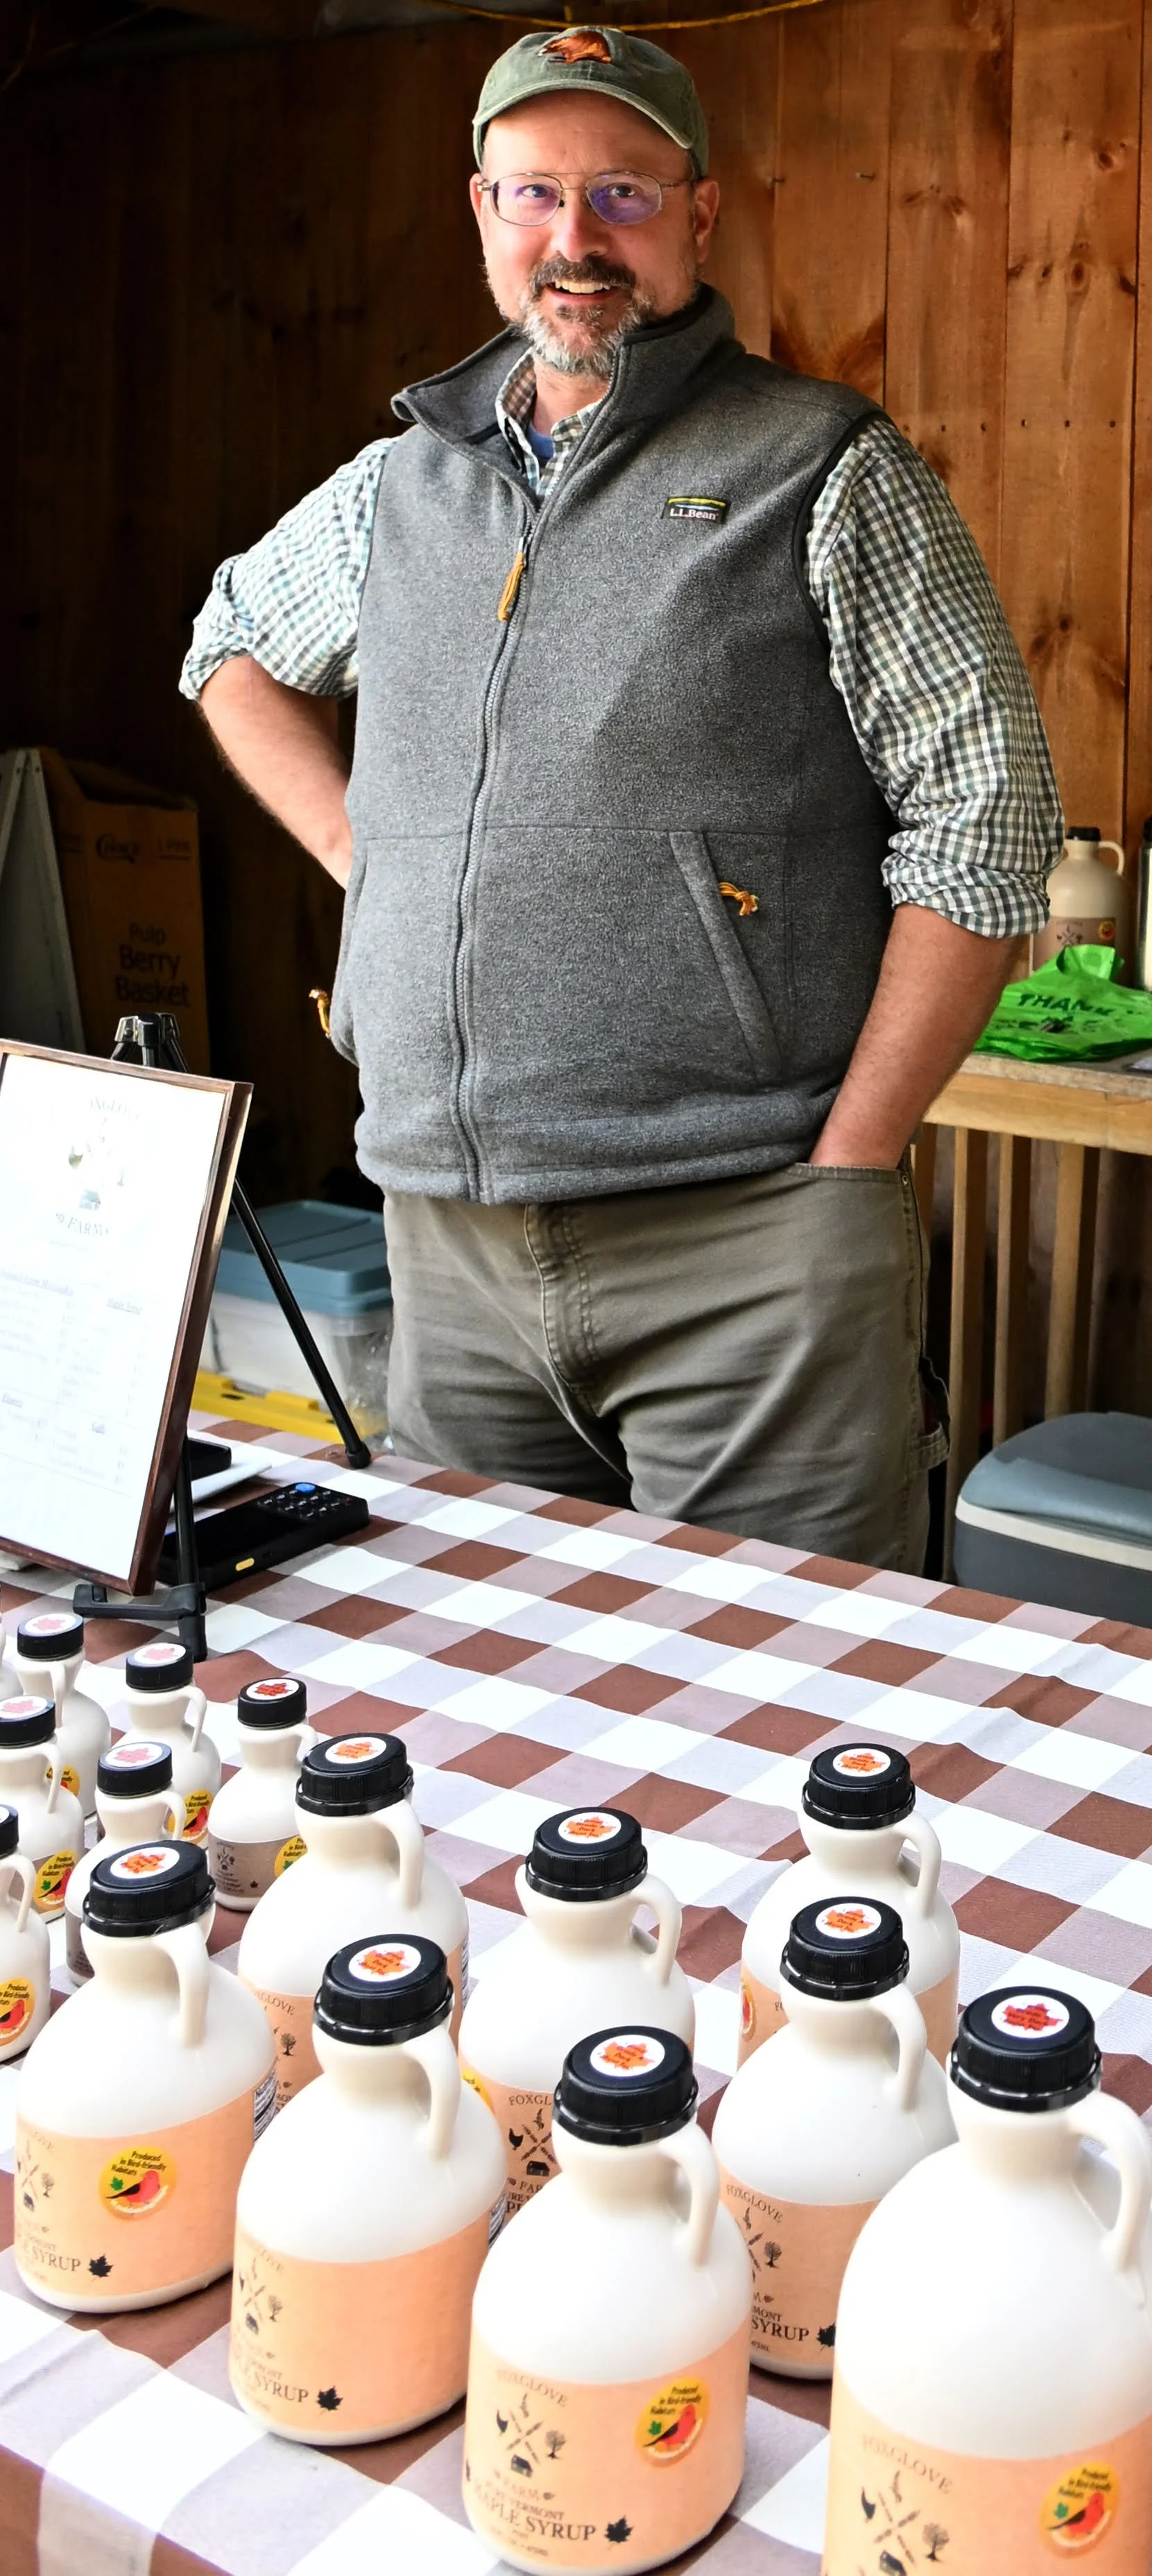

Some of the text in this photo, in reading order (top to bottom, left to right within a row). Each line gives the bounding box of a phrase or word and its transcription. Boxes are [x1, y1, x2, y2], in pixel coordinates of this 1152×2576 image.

[669, 508, 716, 520] L.L.Bean
[129, 922, 166, 946] Pulp
[119, 944, 181, 979] Berry
[115, 976, 190, 1007] Basket
[127, 2159, 166, 2172] Bird-friendly
[132, 2151, 162, 2161] Produced
[111, 2164, 137, 2176] Habitats
[726, 2184, 783, 2223] FOXGLOVE
[32, 2245, 81, 2272] SYRUP
[753, 2306, 782, 2322] MONT
[751, 2317, 809, 2342] SYRUP
[255, 2371, 309, 2403] SYRUP
[526, 2515, 596, 2541] SYRUP
